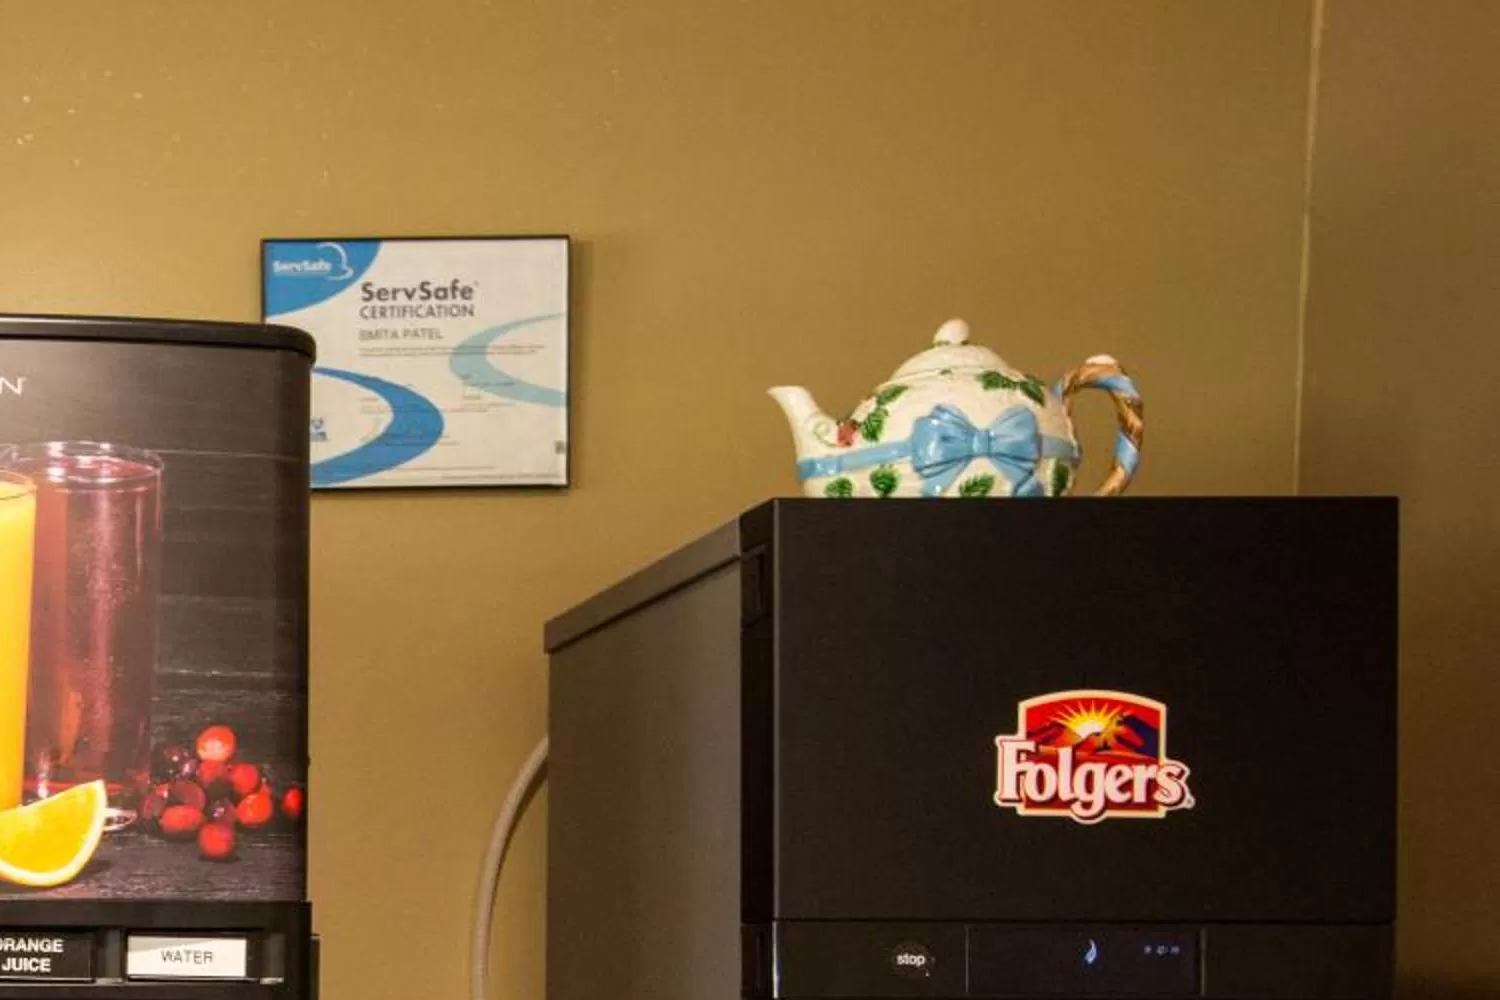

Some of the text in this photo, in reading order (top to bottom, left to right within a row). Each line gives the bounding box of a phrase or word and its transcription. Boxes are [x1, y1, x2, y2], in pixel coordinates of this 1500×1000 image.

[273, 259, 332, 273] ServSafe
[360, 277, 475, 302] ServSafe
[358, 303, 475, 320] CERTIFICATION
[402, 327, 444, 341] PATEL
[999, 740, 1184, 819] Folgers
[161, 949, 213, 964] WATER
[897, 953, 926, 968] stop
[1, 957, 52, 972] JUICE
